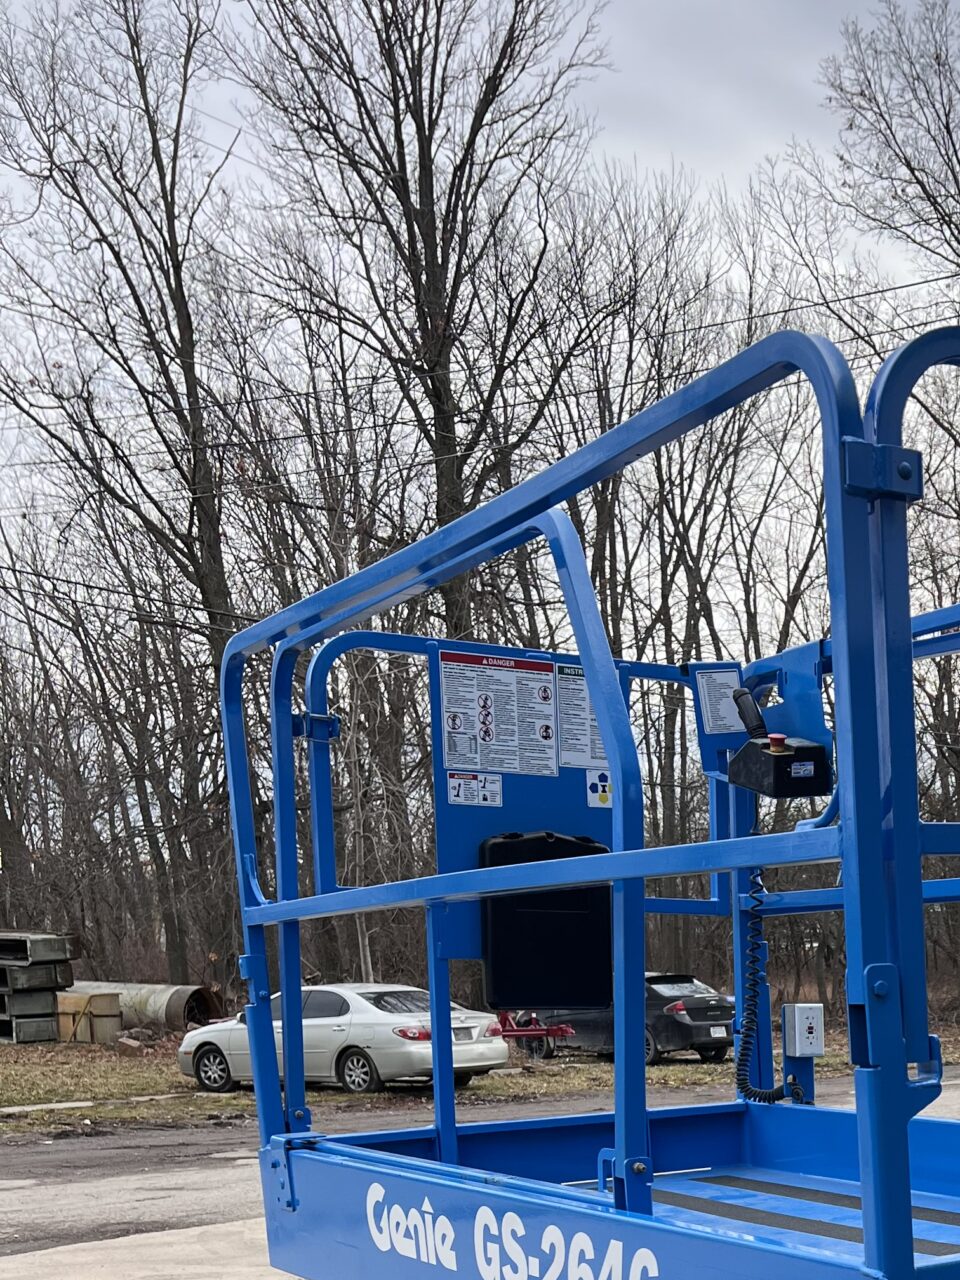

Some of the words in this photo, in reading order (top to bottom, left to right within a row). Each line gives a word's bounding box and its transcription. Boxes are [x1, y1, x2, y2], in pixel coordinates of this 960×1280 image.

[488, 658, 515, 667] DANGER
[563, 667, 583, 675] INSTR
[365, 1181, 458, 1272] Genie
